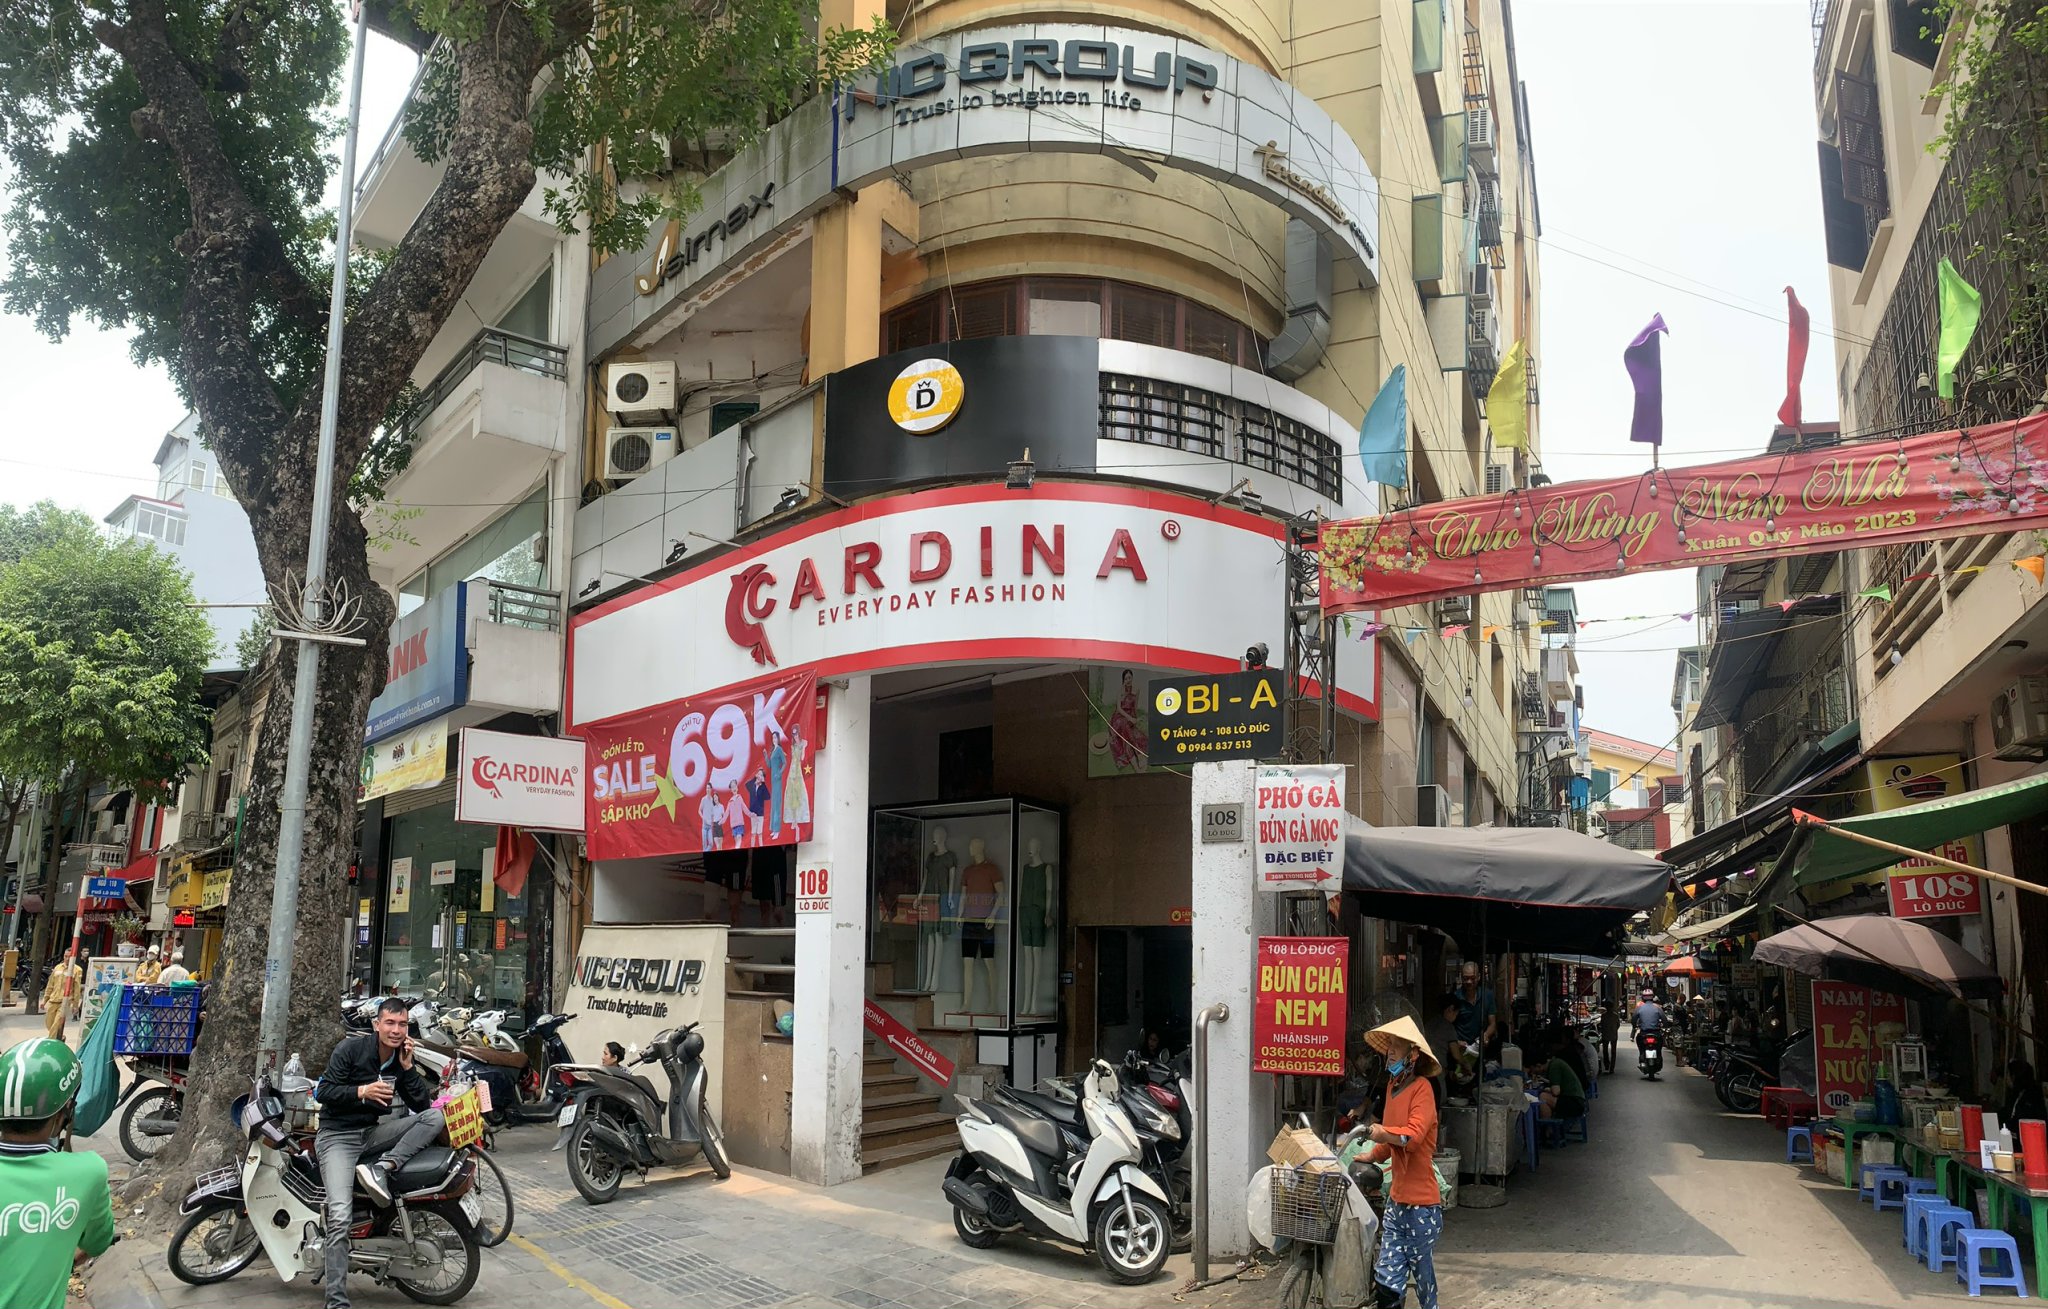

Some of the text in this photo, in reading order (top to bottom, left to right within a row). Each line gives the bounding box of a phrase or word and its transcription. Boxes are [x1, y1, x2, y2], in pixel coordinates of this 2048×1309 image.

[960, 38, 1218, 96] GROUP
[895, 86, 1142, 125] Trust to brighten life
[1428, 510, 1521, 559] Chúc
[1532, 492, 1662, 558] Mừng
[1672, 472, 1790, 528] Năm
[1684, 509, 1917, 553] Xuân Quý Mão 2023
[747, 524, 1148, 619] CARDINA
[818, 583, 1065, 626] EVERYDAY FASHION
[1187, 683, 1220, 714] BI
[1249, 679, 1278, 710] A
[1200, 728, 1207, 737] 4
[1216, 726, 1232, 736] 108
[1234, 722, 1247, 734] LÒ
[1249, 721, 1271, 734] ĐÚC
[633, 741, 645, 753] TO
[1188, 740, 1252, 752] 0984 837 513
[482, 760, 575, 788] CARDINA
[592, 754, 657, 801] SALE
[525, 786, 575, 797] VERYDAY FASHION
[1258, 778, 1341, 810] PHỞ GÀ
[624, 803, 651, 822] KHO
[1206, 810, 1237, 826] 108
[1259, 812, 1339, 848] BÚN GÀ MỌC
[1265, 849, 1334, 866] ĐẶC BIỆT
[799, 868, 830, 896] 108
[1899, 874, 1974, 901] 108
[799, 898, 830, 911] LÒ ĐÚC
[1913, 899, 1966, 913] LÒ ĐÚC
[1267, 944, 1288, 956] 108
[1260, 958, 1345, 994] BÚN CHẢ
[586, 995, 669, 1019] Trust to brighten life
[1821, 990, 1865, 1007] NAM
[1275, 998, 1328, 1027] NEM
[1261, 1046, 1341, 1060] 0363020486
[59, 1059, 81, 1093] Grab
[1261, 1059, 1341, 1073] 0946015246
[1828, 1093, 1851, 1108] 108
[255, 1193, 278, 1201] HONDA
